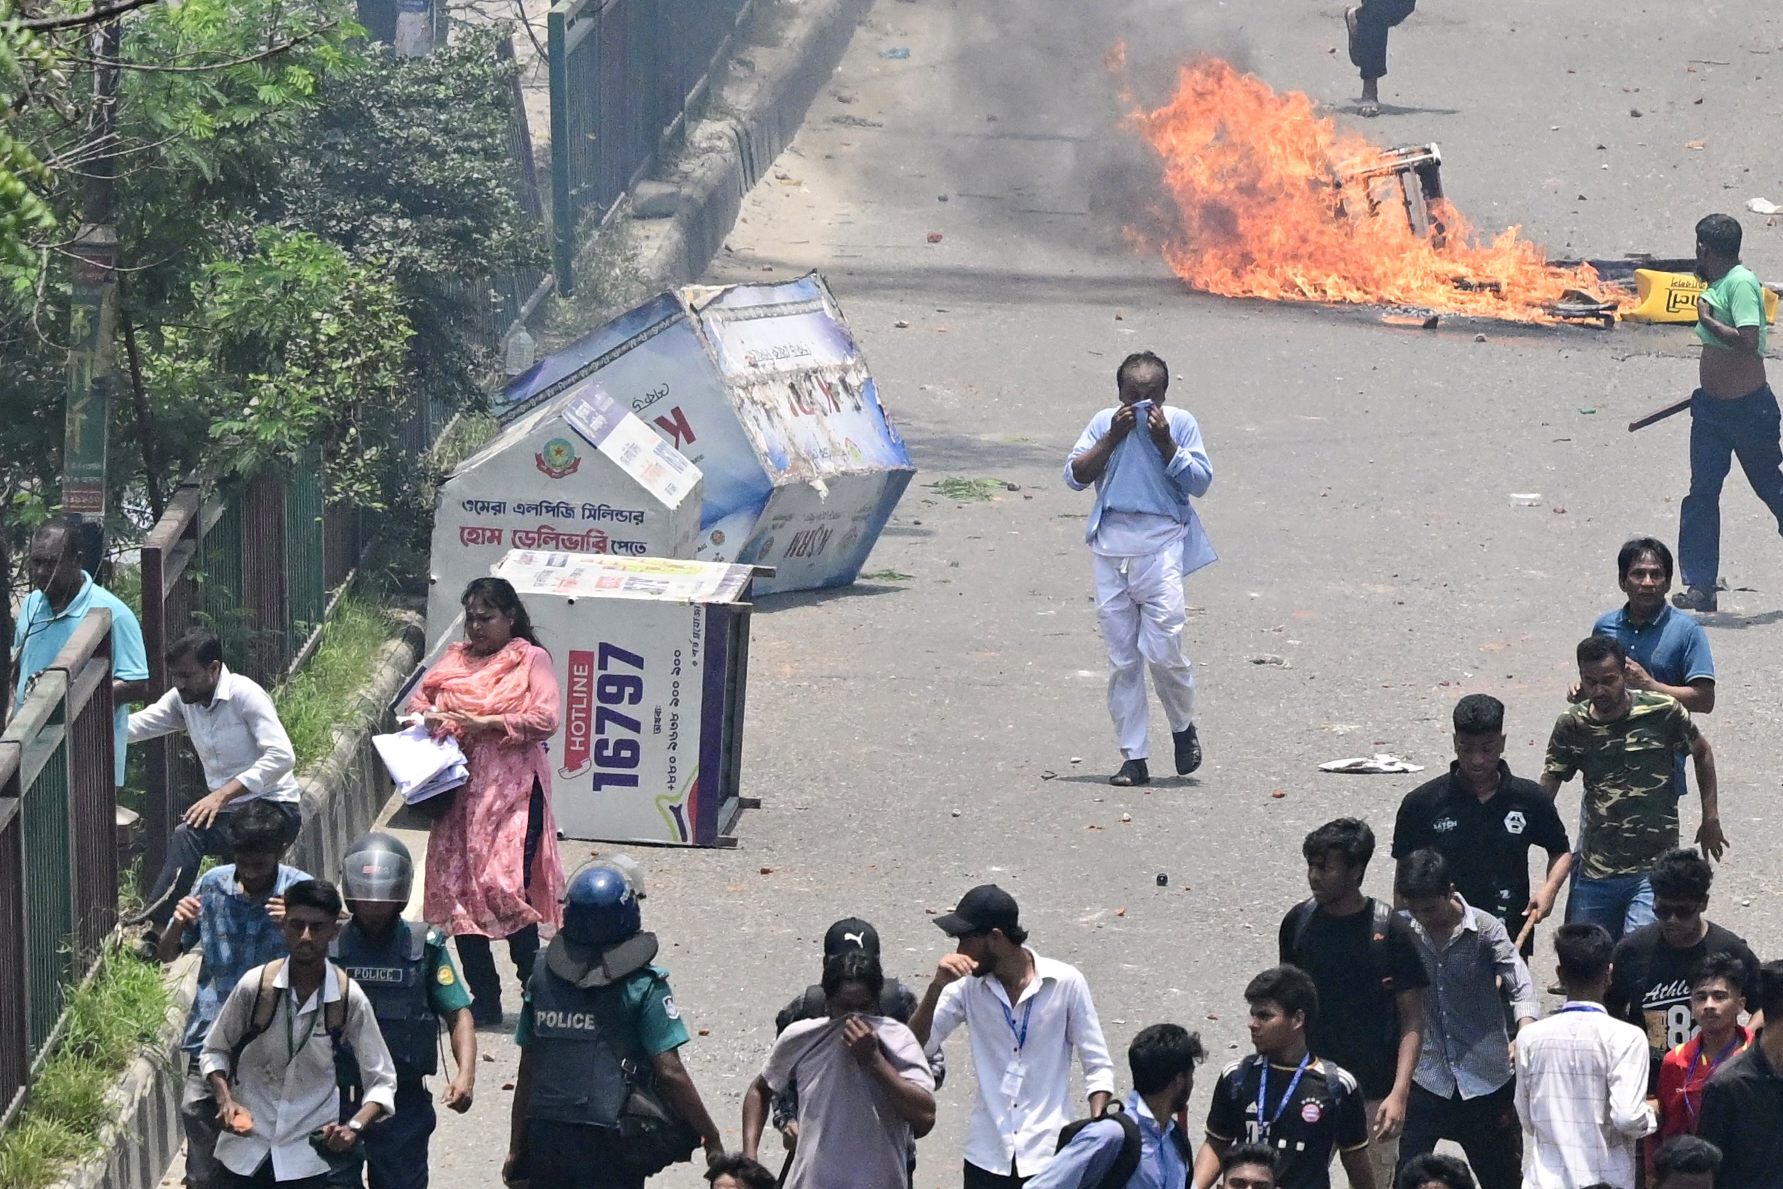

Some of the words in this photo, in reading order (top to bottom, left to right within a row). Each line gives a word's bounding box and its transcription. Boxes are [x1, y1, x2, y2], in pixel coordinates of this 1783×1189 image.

[462, 499, 507, 516] ওমেরা
[513, 500, 576, 520] এলপিজি
[581, 503, 645, 526] সিলিন্ডার
[459, 525, 503, 547] হোম
[511, 524, 609, 554] ডেলিভারি
[611, 539, 647, 556] পেতে
[671, 649, 682, 676] ৯০০
[570, 664, 589, 751] HOTLINE
[669, 681, 680, 707] ৯০০
[592, 642, 645, 792] 16797
[667, 712, 679, 751] ৯৬৩৮
[666, 755, 677, 791] +৮৮০
[354, 968, 393, 980] POLICE
[537, 1011, 595, 1030] POLICE
